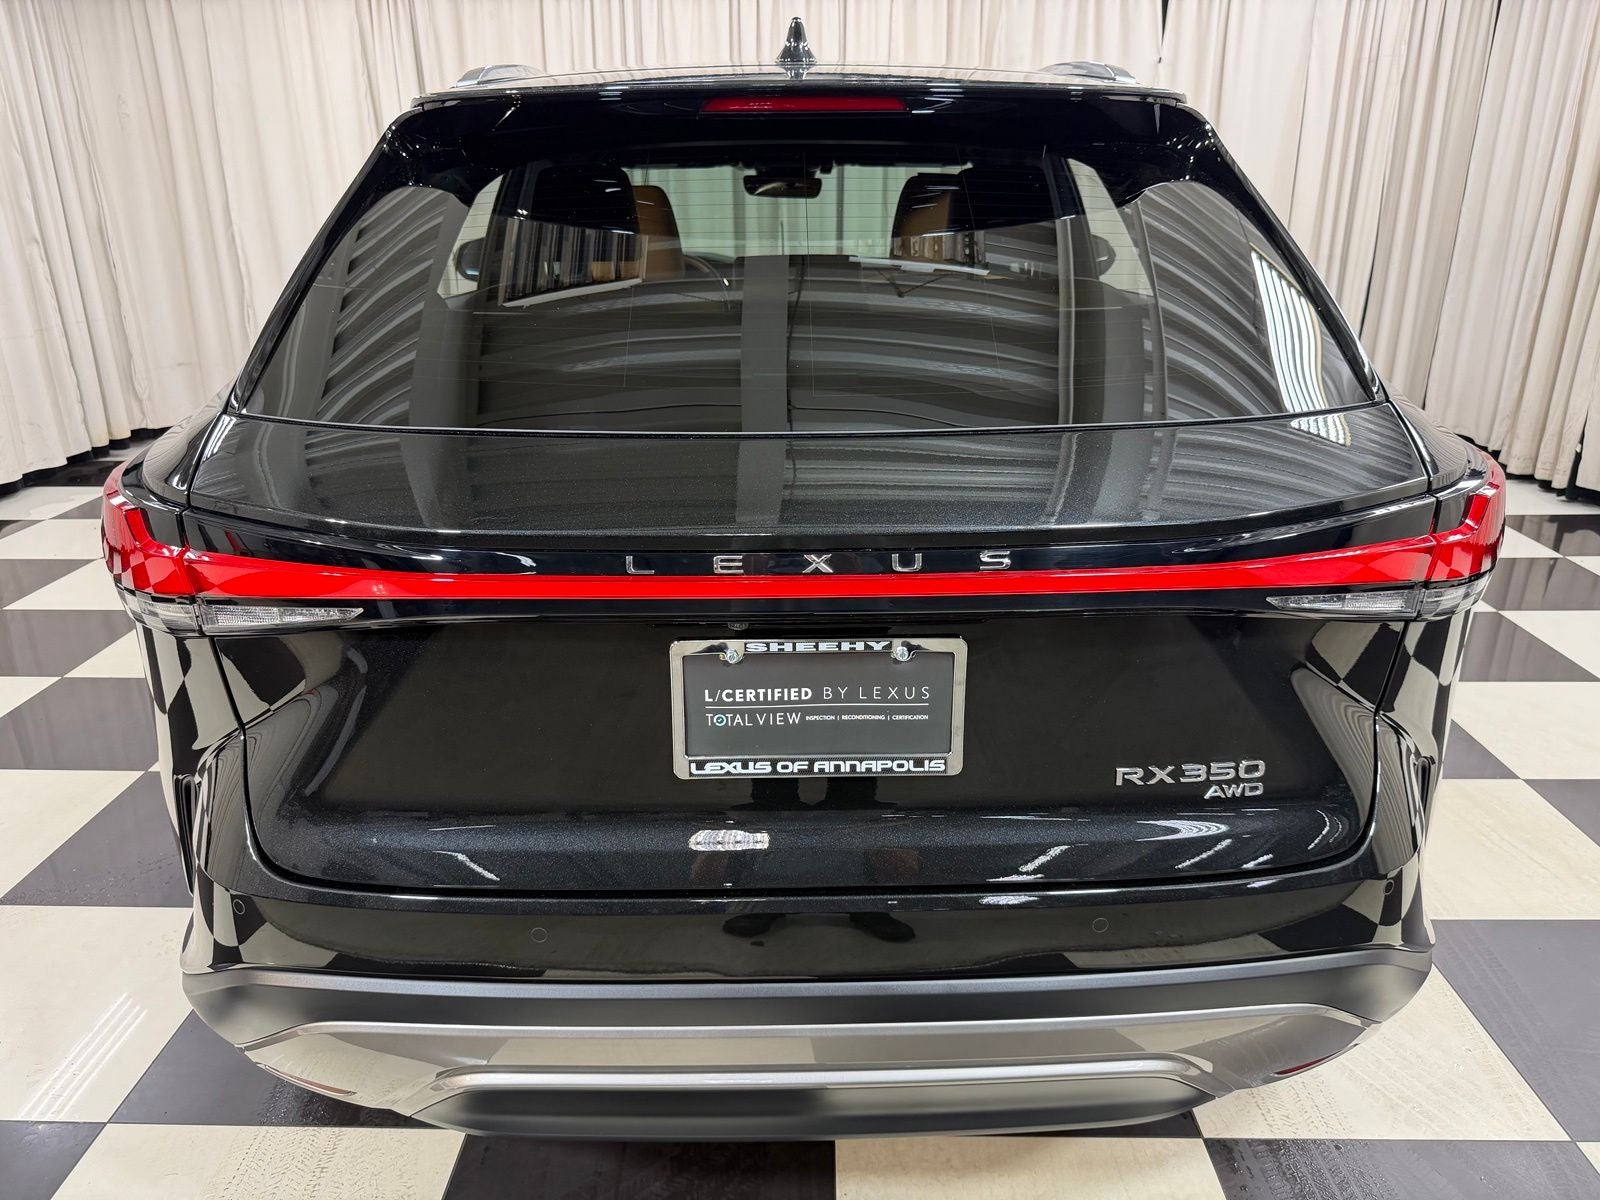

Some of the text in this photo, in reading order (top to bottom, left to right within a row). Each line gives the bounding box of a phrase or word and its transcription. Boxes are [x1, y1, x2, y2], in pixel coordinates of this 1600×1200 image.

[626, 549, 1011, 575] LEXUS
[745, 641, 891, 652] SHEEHY
[704, 686, 930, 702] L/CERTIFIED BY LEXUS
[690, 759, 946, 775] LEXUS OF ANNAPOLIS
[1204, 782, 1264, 800] AWD
